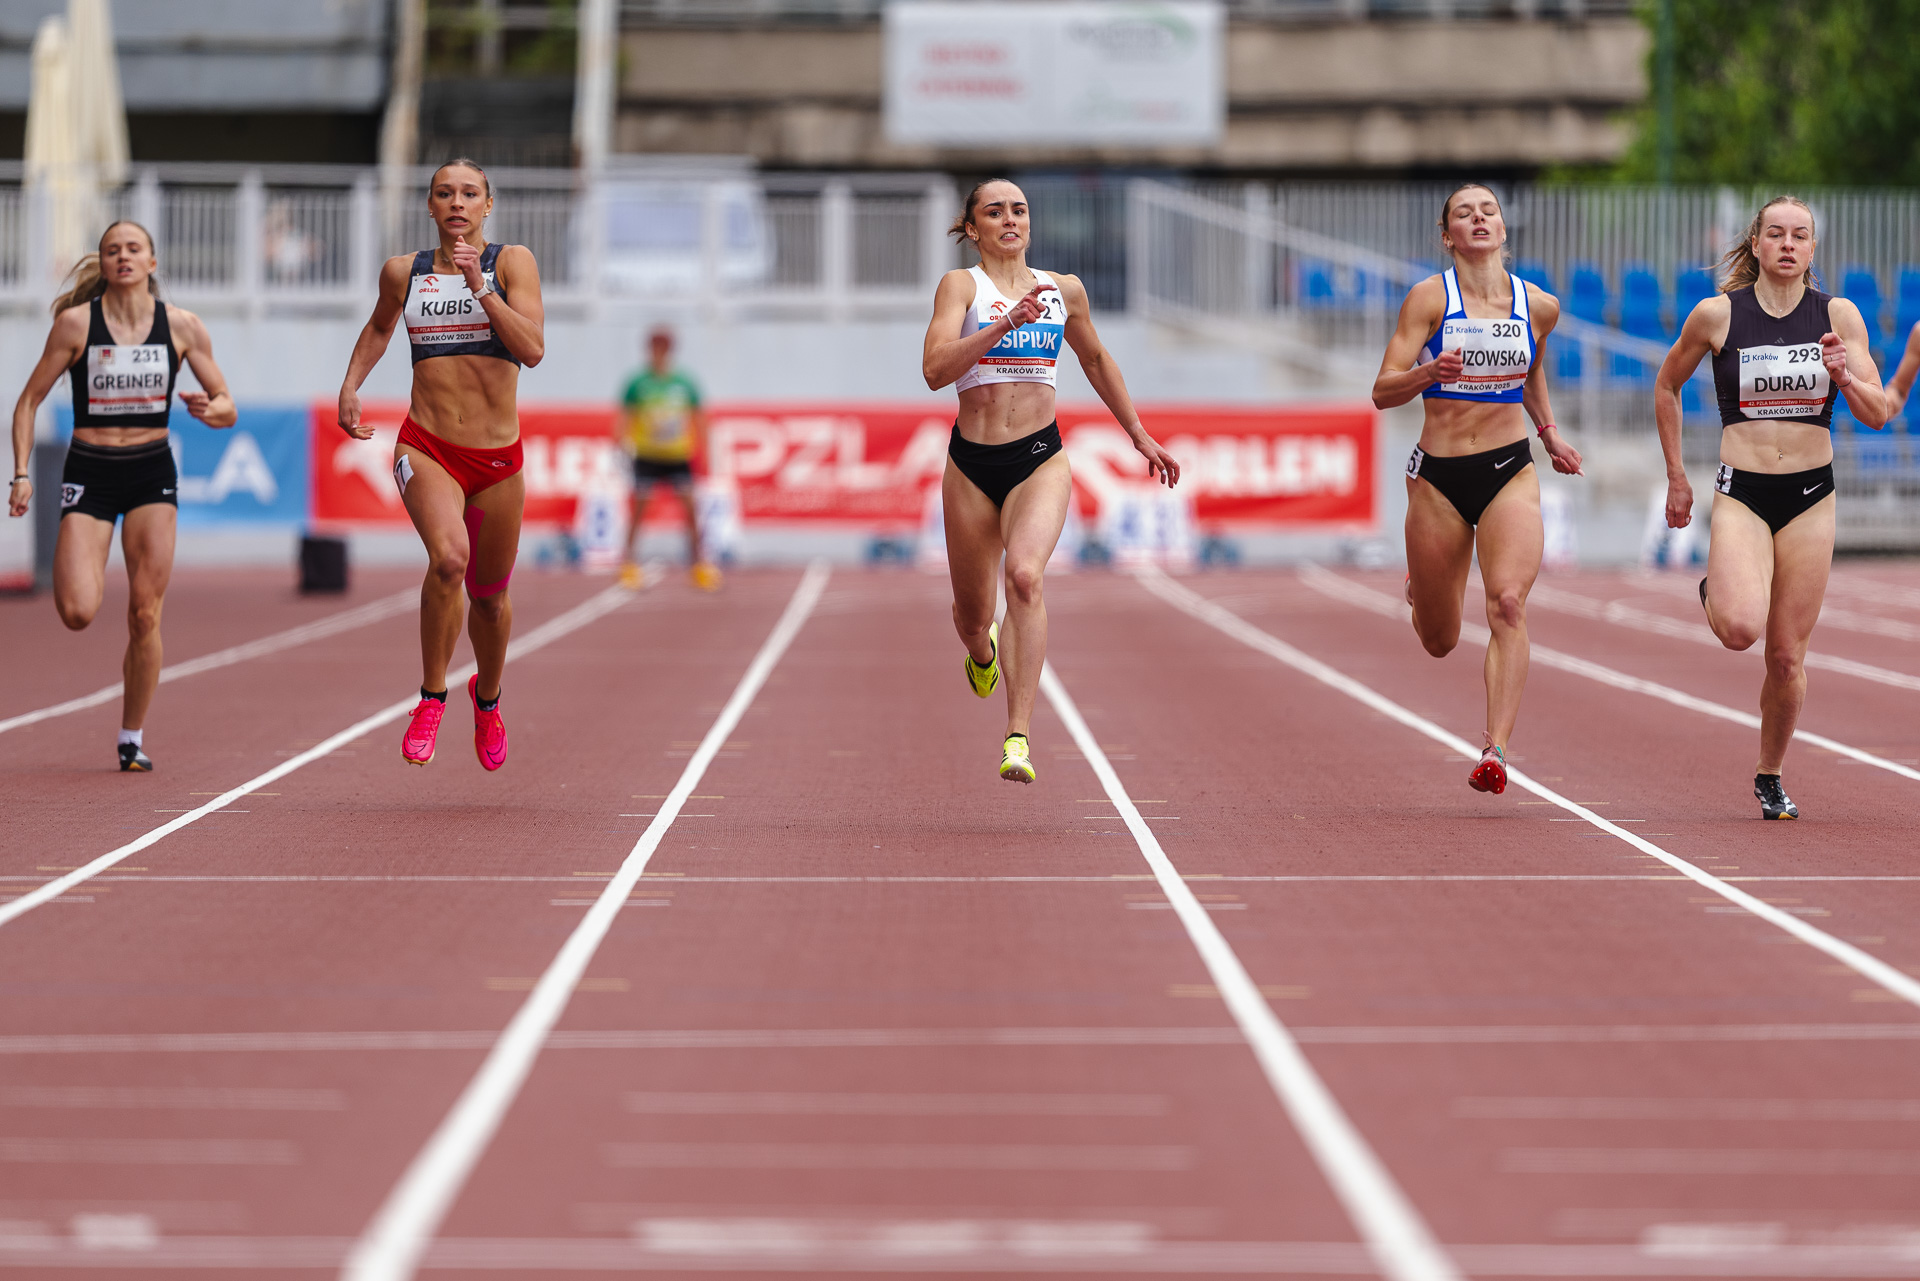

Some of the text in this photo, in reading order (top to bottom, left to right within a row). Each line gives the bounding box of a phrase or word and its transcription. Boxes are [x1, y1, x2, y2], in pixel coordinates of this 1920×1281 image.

[421, 299, 473, 316] KUBIS
[421, 333, 455, 342] KRAKÓW
[1455, 323, 1521, 337] Kraków 320
[132, 349, 160, 363] 231
[1752, 347, 1821, 363] Kraków 293
[996, 366, 1034, 374] KRAKÓW
[93, 373, 163, 390] GREINER
[1754, 374, 1817, 393] DURAJ
[1757, 407, 1794, 416] KRAKÓW
[1408, 450, 1419, 473] 5
